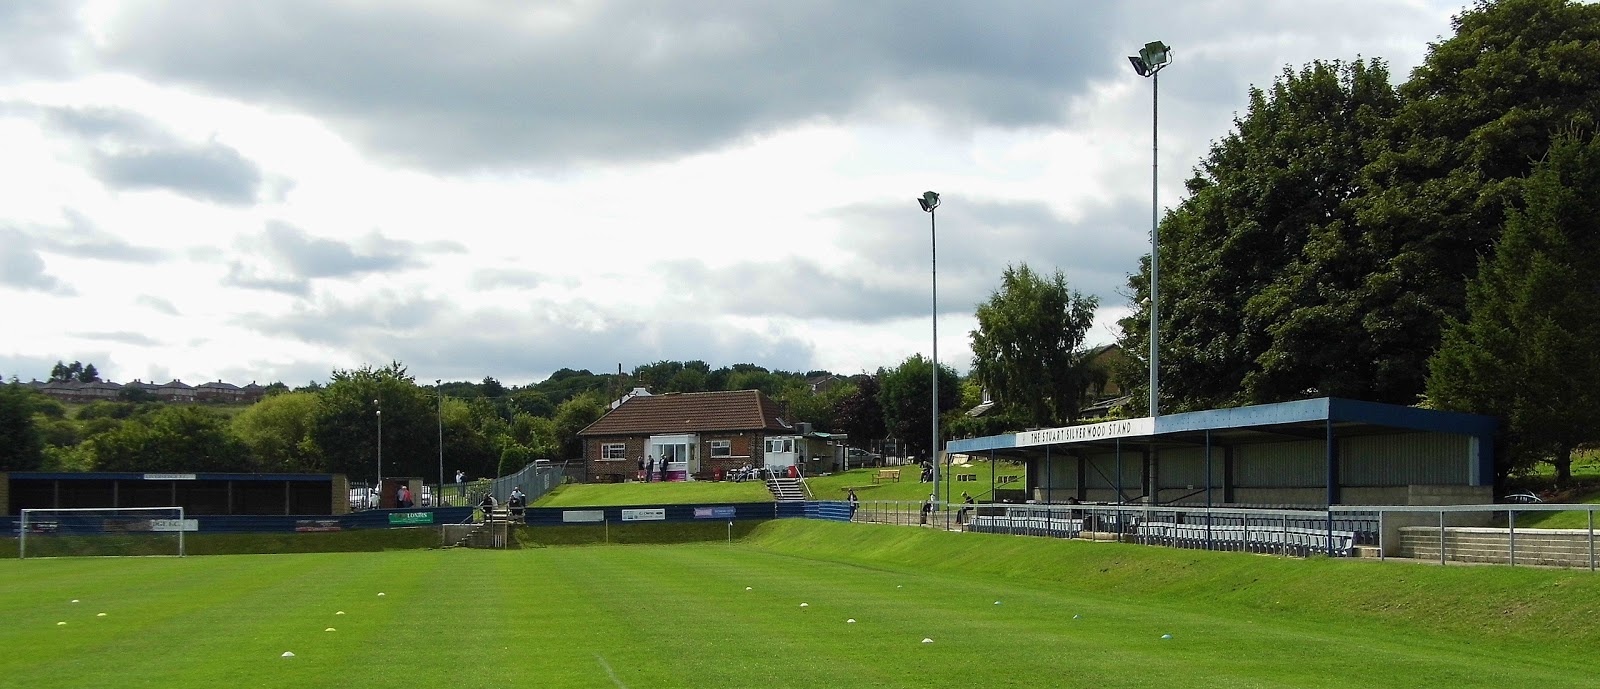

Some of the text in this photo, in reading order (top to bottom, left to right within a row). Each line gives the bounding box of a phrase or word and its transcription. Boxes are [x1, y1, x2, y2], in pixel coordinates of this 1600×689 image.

[1031, 422, 1131, 443] THE STUART SILVERWOOD STAND
